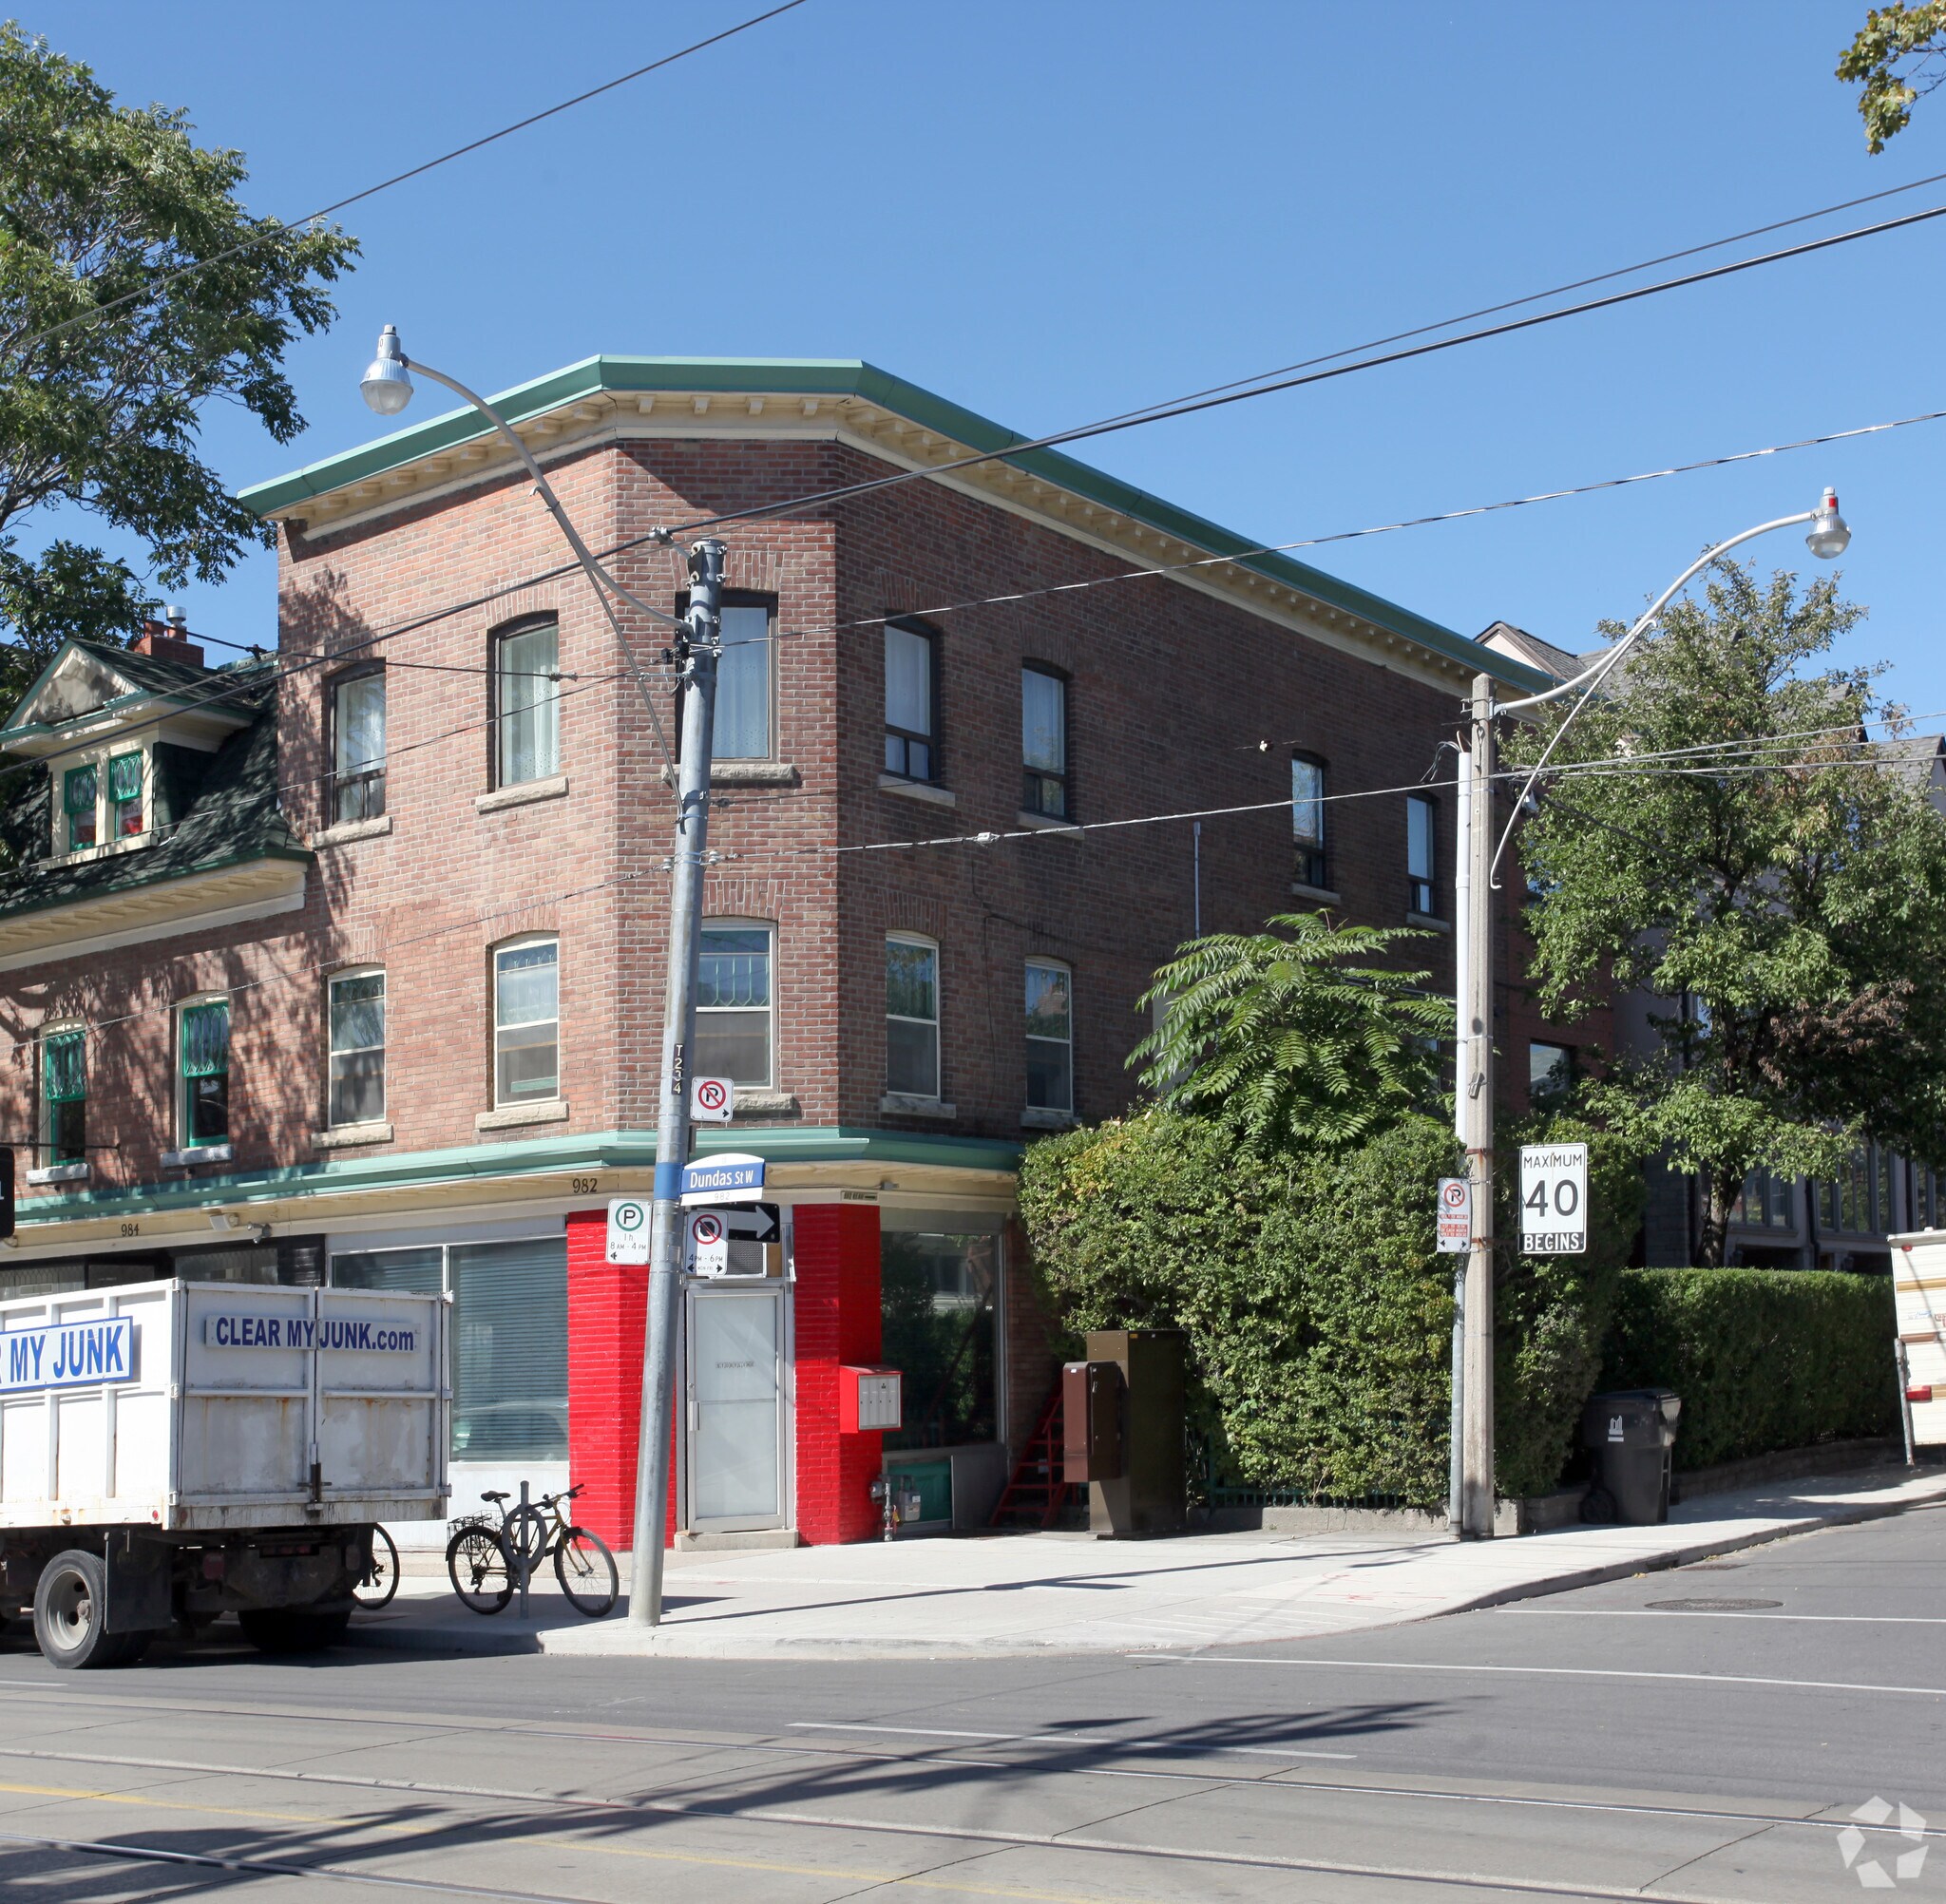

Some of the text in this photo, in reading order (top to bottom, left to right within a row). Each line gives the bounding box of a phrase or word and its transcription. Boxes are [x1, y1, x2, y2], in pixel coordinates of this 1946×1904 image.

[674, 1044, 683, 1094] T234
[1523, 1153, 1583, 1169] MAXIMUM
[572, 1177, 598, 1194] 982
[690, 1170, 754, 1189] Dundas St W
[715, 1191, 731, 1202] 982
[1526, 1179, 1578, 1217] 40
[121, 1223, 140, 1237] 984
[1523, 1233, 1580, 1251] BEGINS
[216, 1317, 414, 1351] CLEAR MY JUNK.com
[10, 1334, 47, 1382] MY
[53, 1324, 124, 1379] JUNK
